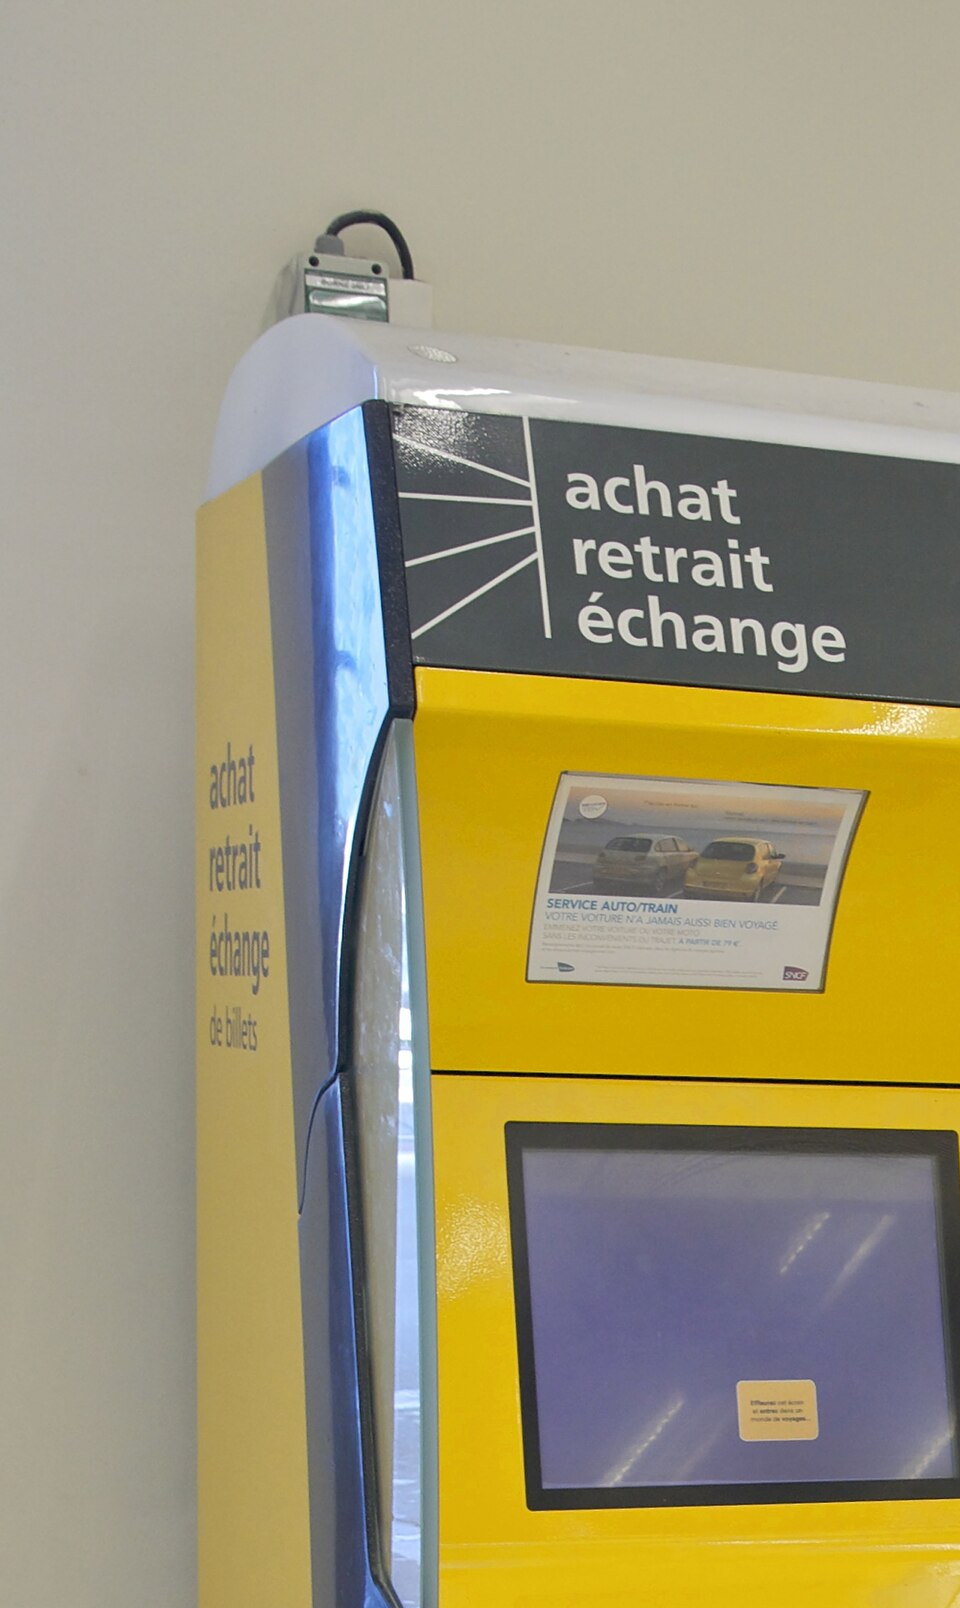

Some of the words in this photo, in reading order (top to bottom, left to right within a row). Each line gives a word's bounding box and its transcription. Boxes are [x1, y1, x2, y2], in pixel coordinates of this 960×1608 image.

[565, 464, 741, 525] achat
[572, 536, 774, 592] retrait
[577, 592, 847, 673] échange
[209, 741, 255, 810] achat
[209, 824, 261, 892] retrait
[545, 911, 578, 921] VOTRE
[581, 913, 623, 923] VOITURE
[646, 916, 682, 926] JAMAIS
[683, 918, 711, 928] AUSSI
[714, 919, 736, 929] BIEN
[546, 898, 598, 910] SERVICE
[601, 900, 678, 914] AUTO/TRAIN
[210, 912, 270, 995] échange
[784, 971, 807, 979] SNCF
[209, 1005, 222, 1047] de
[225, 1006, 258, 1051] billets
